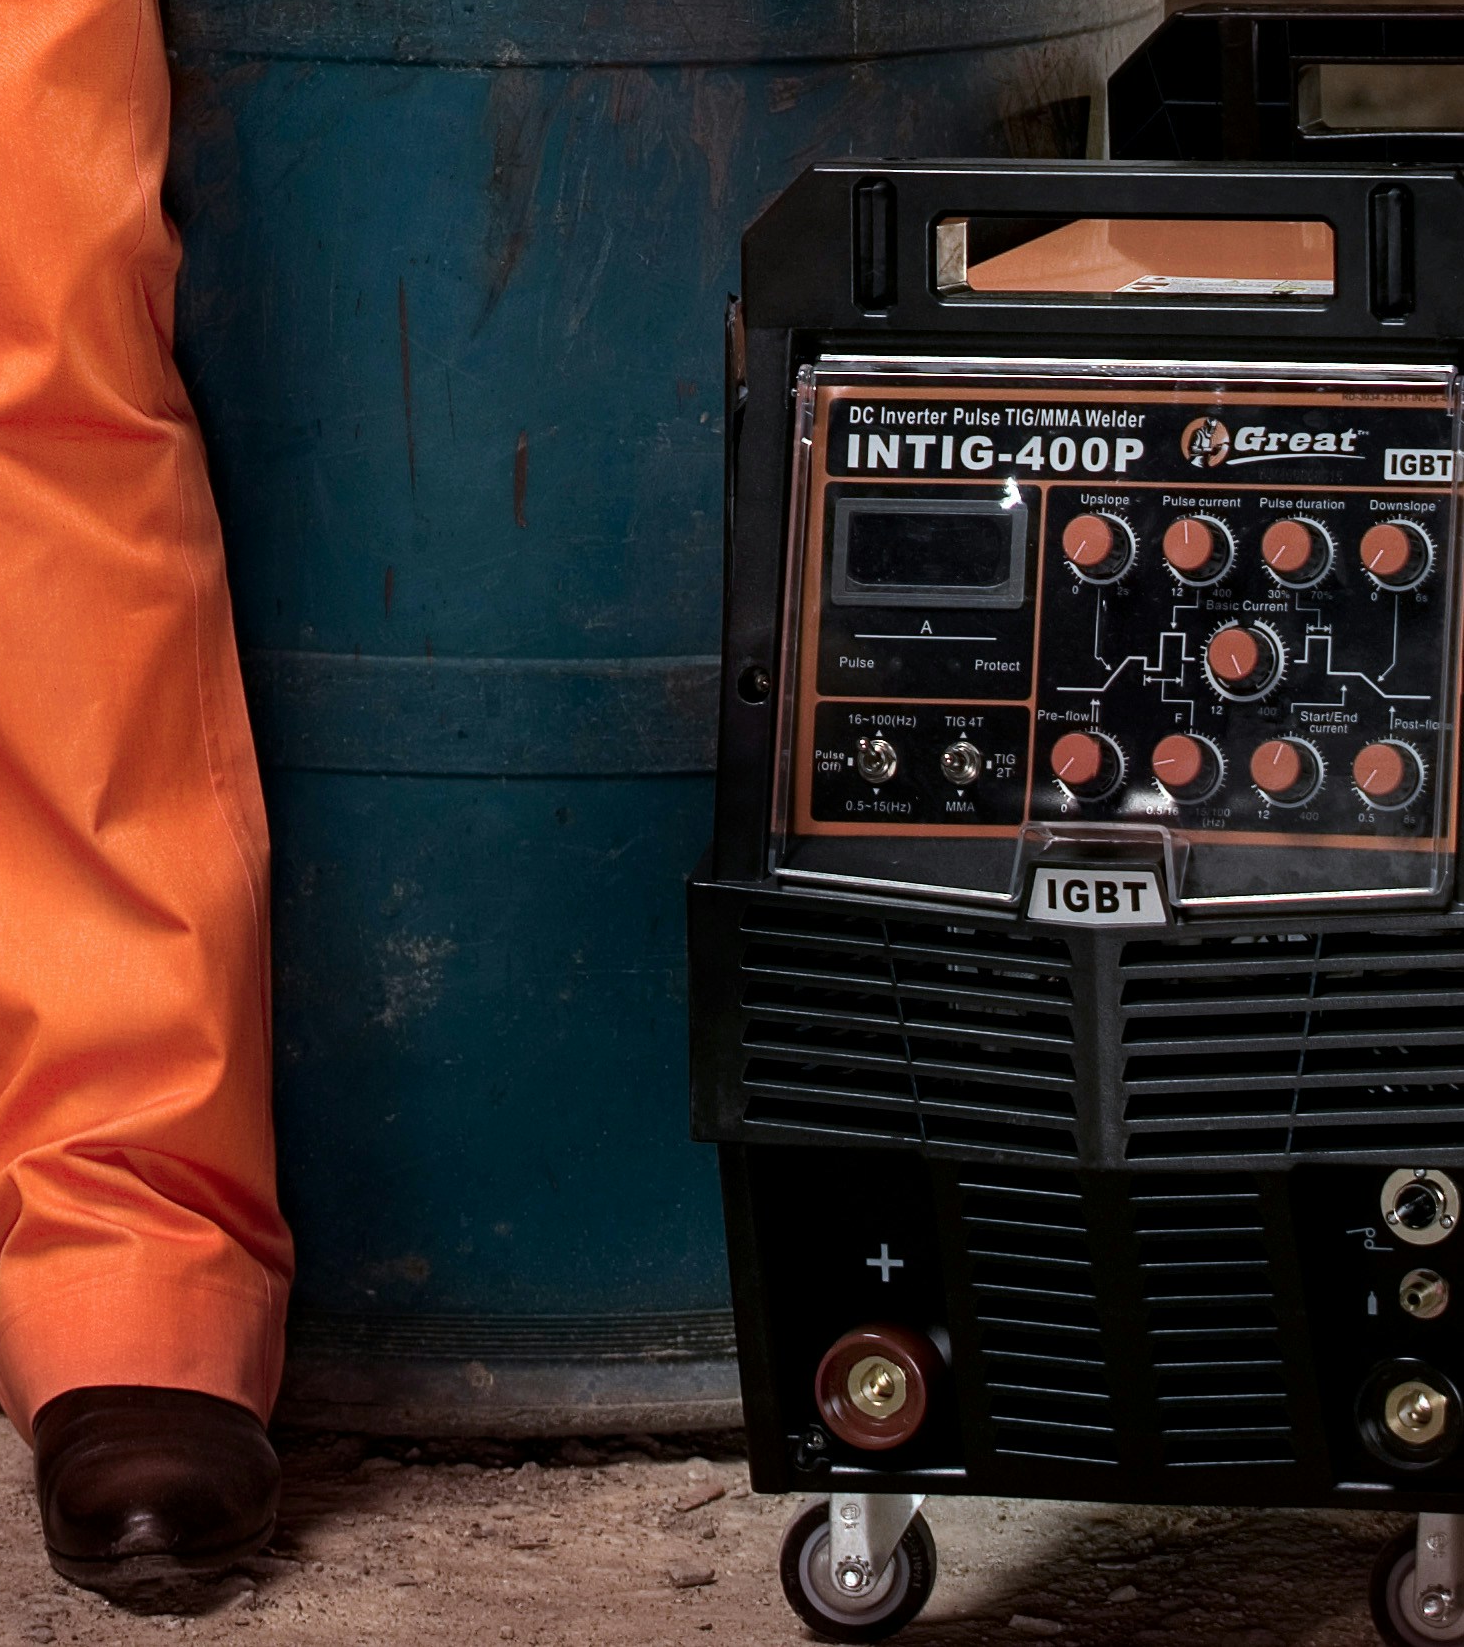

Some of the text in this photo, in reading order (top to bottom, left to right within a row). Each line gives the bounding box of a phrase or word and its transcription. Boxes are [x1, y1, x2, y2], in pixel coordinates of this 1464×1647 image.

[849, 406, 1146, 427] DC Inverter Pulse TIG/MMA Welder
[1234, 426, 1356, 452] Great
[847, 434, 1144, 472] INTIG-400P
[1390, 453, 1452, 476] IGBT
[1080, 494, 1130, 506] Upslope
[1162, 496, 1241, 508] Pulse current
[1260, 497, 1345, 510] Pulse duration
[1370, 500, 1436, 512] Downslope
[1072, 586, 1079, 595] 0
[1172, 587, 1183, 597] 12
[1213, 589, 1232, 598] 400
[1268, 590, 1290, 599] 30%
[1370, 592, 1378, 601] 0
[1206, 600, 1288, 612] Basic Current
[920, 620, 933, 634] A
[839, 657, 874, 668] Pulse
[975, 660, 1020, 671] Protect
[1037, 710, 1090, 721] Pre-flow
[1211, 706, 1223, 715] 12
[1257, 707, 1276, 715] 400
[1301, 710, 1357, 722] Start/End
[849, 714, 917, 727] 16~100(Hz)
[945, 716, 984, 727] TIG 4T
[1175, 713, 1183, 723] F
[1310, 724, 1348, 734] current
[815, 750, 844, 760] Pulse
[994, 753, 1015, 764] TIG
[817, 762, 841, 772] (Off)
[996, 767, 1012, 777] 2T
[846, 801, 911, 813] 0.5~15(Hz)
[946, 801, 975, 812] MMA
[1060, 804, 1067, 813] 0
[1257, 810, 1269, 819] 12
[1300, 812, 1319, 820] 400
[1358, 813, 1375, 822] 0.5
[1202, 817, 1226, 828] (Hz)
[1047, 879, 1147, 913] IGBT
